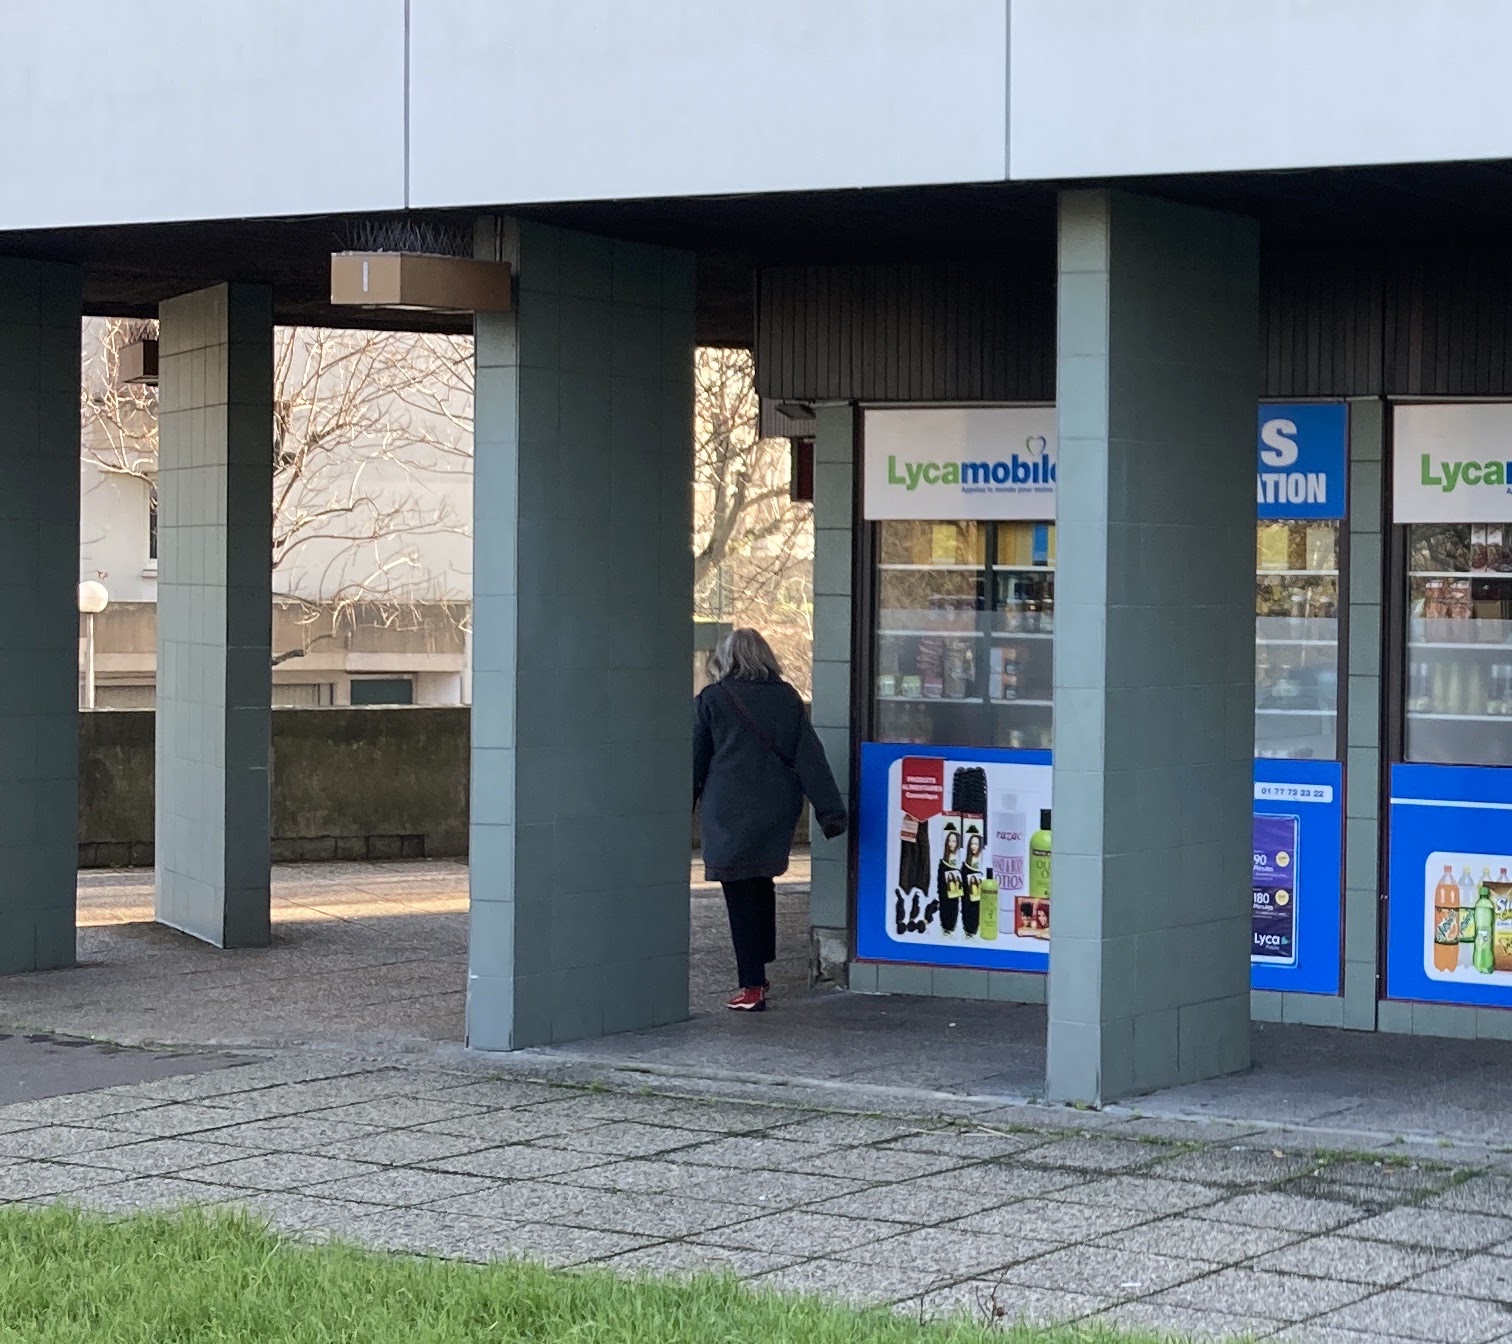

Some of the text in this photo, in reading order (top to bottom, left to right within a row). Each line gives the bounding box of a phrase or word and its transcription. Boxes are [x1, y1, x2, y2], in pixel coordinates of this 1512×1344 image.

[1260, 419, 1298, 467] S
[1261, 787, 1324, 798] 01 77 72 23 22
[1254, 932, 1280, 946] Lyca
